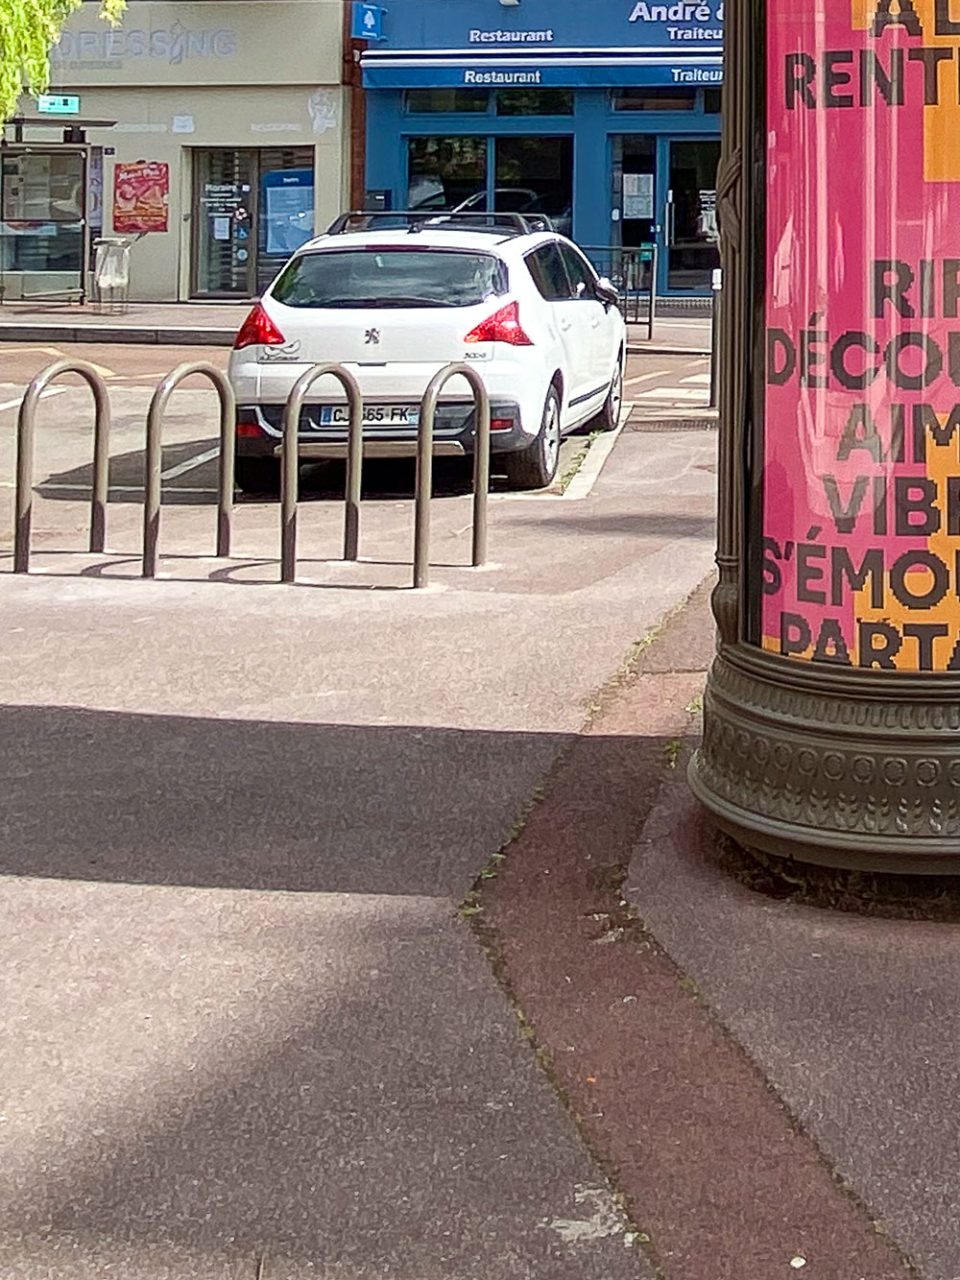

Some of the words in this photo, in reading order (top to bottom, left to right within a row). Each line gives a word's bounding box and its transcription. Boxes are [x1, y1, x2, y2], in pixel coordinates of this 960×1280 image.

[628, 0, 710, 22] André
[469, 29, 554, 42] Restaurant
[666, 26, 723, 41] Traiteu
[464, 70, 541, 84] Restaurant
